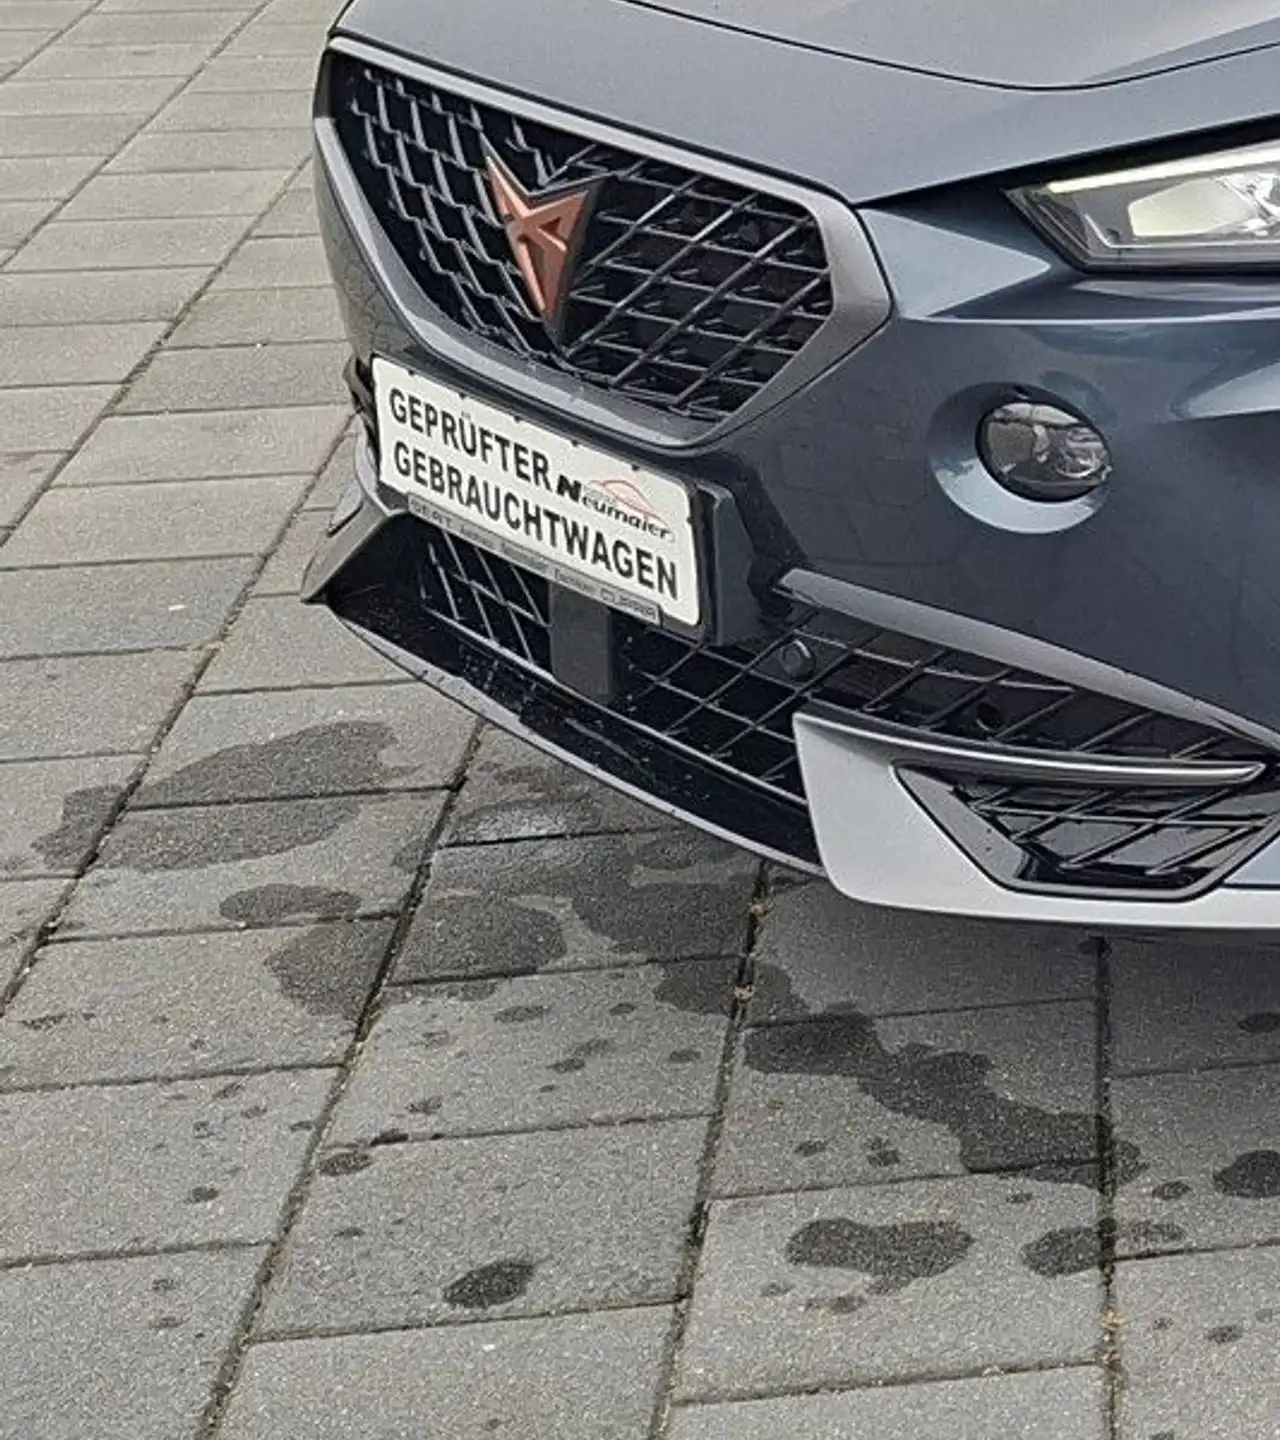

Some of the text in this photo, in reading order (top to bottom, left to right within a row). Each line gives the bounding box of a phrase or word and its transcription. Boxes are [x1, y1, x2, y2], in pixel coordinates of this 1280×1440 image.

[389, 387, 673, 540] GEPRÜFTER Neumaier
[394, 441, 679, 601] GEBRAUCHTWAGEN
